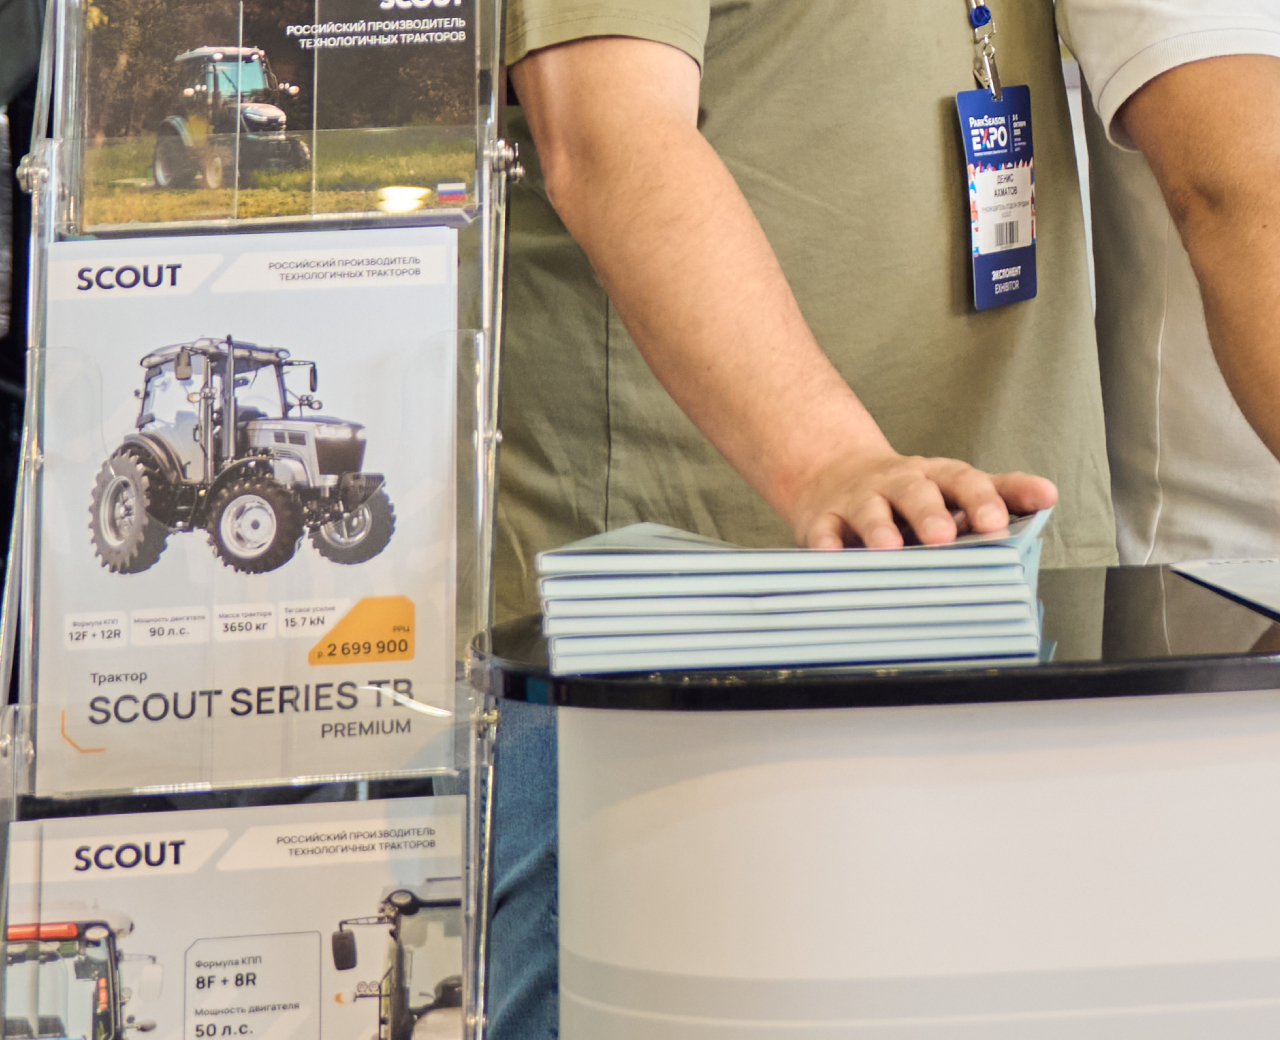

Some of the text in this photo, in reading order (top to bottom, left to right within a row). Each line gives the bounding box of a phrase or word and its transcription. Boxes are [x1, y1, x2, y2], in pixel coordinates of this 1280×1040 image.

[286, 17, 466, 36] РОССИЙСКИЙ ПРОИЗВОДИТЕЛЬ
[299, 31, 466, 48] ТЕХНОЛОГИЧНЫХ ТРАКТОРОВ
[971, 126, 1007, 150] EXPO
[268, 256, 421, 270] РОССИЙСКИЙ ПРОИЗВОДИТЕЛЬ
[77, 263, 182, 291] SCOUT
[279, 267, 421, 281] ТЕХНОЛОГИЧНЫХ ТРАКТОРОВ
[223, 621, 268, 633] 3650 кг
[309, 616, 325, 626] kN
[69, 631, 88, 641] 12F
[100, 629, 121, 640] 12R
[149, 626, 164, 637] 90
[327, 644, 337, 656] 2
[341, 642, 372, 655] 699
[376, 639, 408, 654] 900
[90, 670, 148, 686] Трактор
[87, 678, 414, 726] SCOUT SERIES TB
[320, 718, 412, 739] PREMIUM
[276, 827, 435, 844] РОССИЙСКИЙ ПРОИЗВОДИТЕЛЬ
[74, 840, 186, 872] SCOUT
[288, 839, 436, 857] ТЕХНОЛОГИЧНЫХ ТРАКТОРОВ
[195, 956, 262, 969] Формула КПП
[196, 975, 216, 989] 8F
[234, 972, 257, 987] 8R
[195, 1003, 300, 1016] Мощность двигателя
[195, 1023, 253, 1038] 50 л.с.
